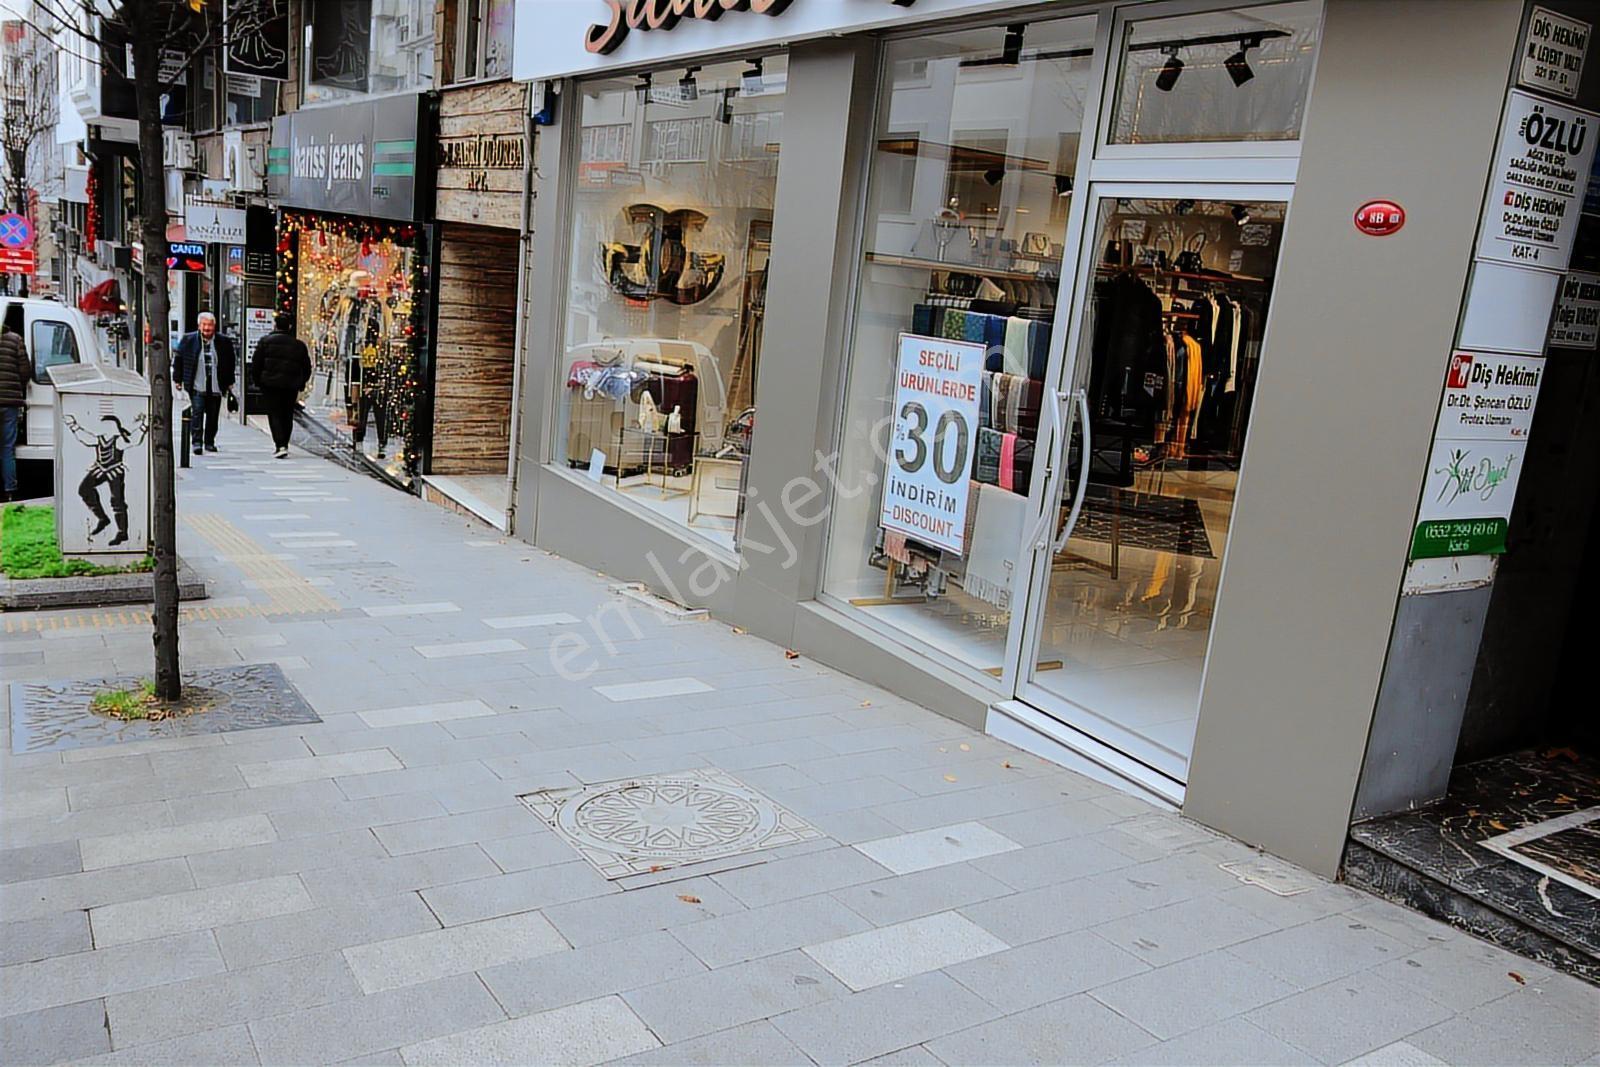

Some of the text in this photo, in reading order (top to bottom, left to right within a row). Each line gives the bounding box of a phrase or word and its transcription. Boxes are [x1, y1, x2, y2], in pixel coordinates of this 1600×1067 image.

[1525, 105, 1587, 156] ÖZLÜ
[326, 132, 365, 191] jeans
[1513, 192, 1567, 218] DİŞ HEKİMİ
[918, 349, 961, 374] SEÇİLİ
[1471, 363, 1540, 389] Diş Hekimi
[900, 370, 976, 402] ÜRÜNLERDE
[1507, 393, 1532, 411] ÖZLÜ
[890, 475, 957, 514] İNDİRİM
[892, 505, 954, 539] DISCOUNT
